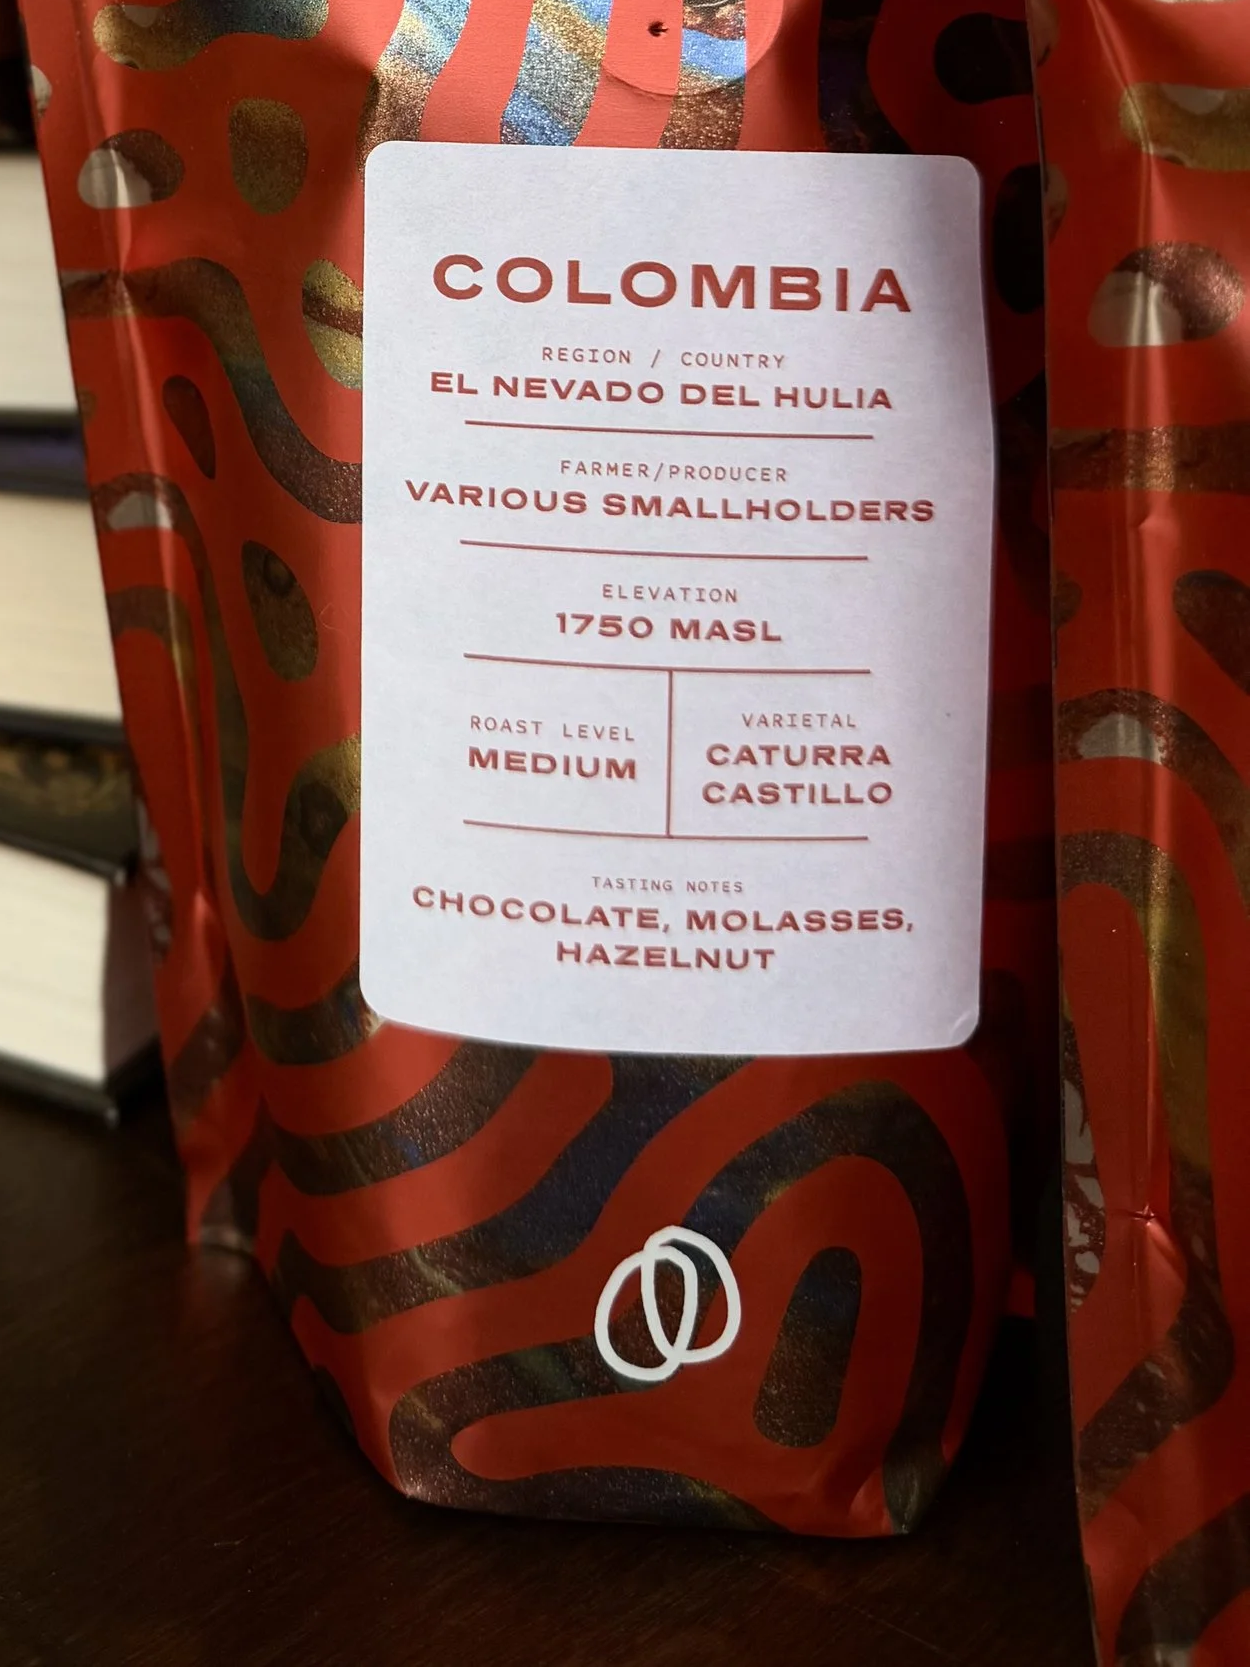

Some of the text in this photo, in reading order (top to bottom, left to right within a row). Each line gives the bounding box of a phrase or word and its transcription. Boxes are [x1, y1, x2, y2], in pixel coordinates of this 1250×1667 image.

[432, 253, 912, 313] COLOMBIA
[541, 346, 785, 369] REGION / COUNTRY
[430, 371, 893, 410] EL NEVADO DEL HULIA
[560, 459, 788, 483] FARMER/PRODUCER
[404, 479, 935, 523] VARIOUS SMALLHOLDERS
[602, 583, 739, 604] ELEVATION
[555, 611, 783, 643] 1750 MASL
[470, 714, 636, 743] ROAST LEVEL
[741, 712, 857, 730] VARIETAL
[468, 745, 637, 781] MEDIUM
[705, 743, 892, 768] CATURRA
[701, 781, 893, 806] CASTILLO
[591, 875, 745, 895] TASTING NOTES
[412, 884, 914, 934] CHOCOLATE, MOLASSES,
[556, 940, 776, 972] HAZELNUT
